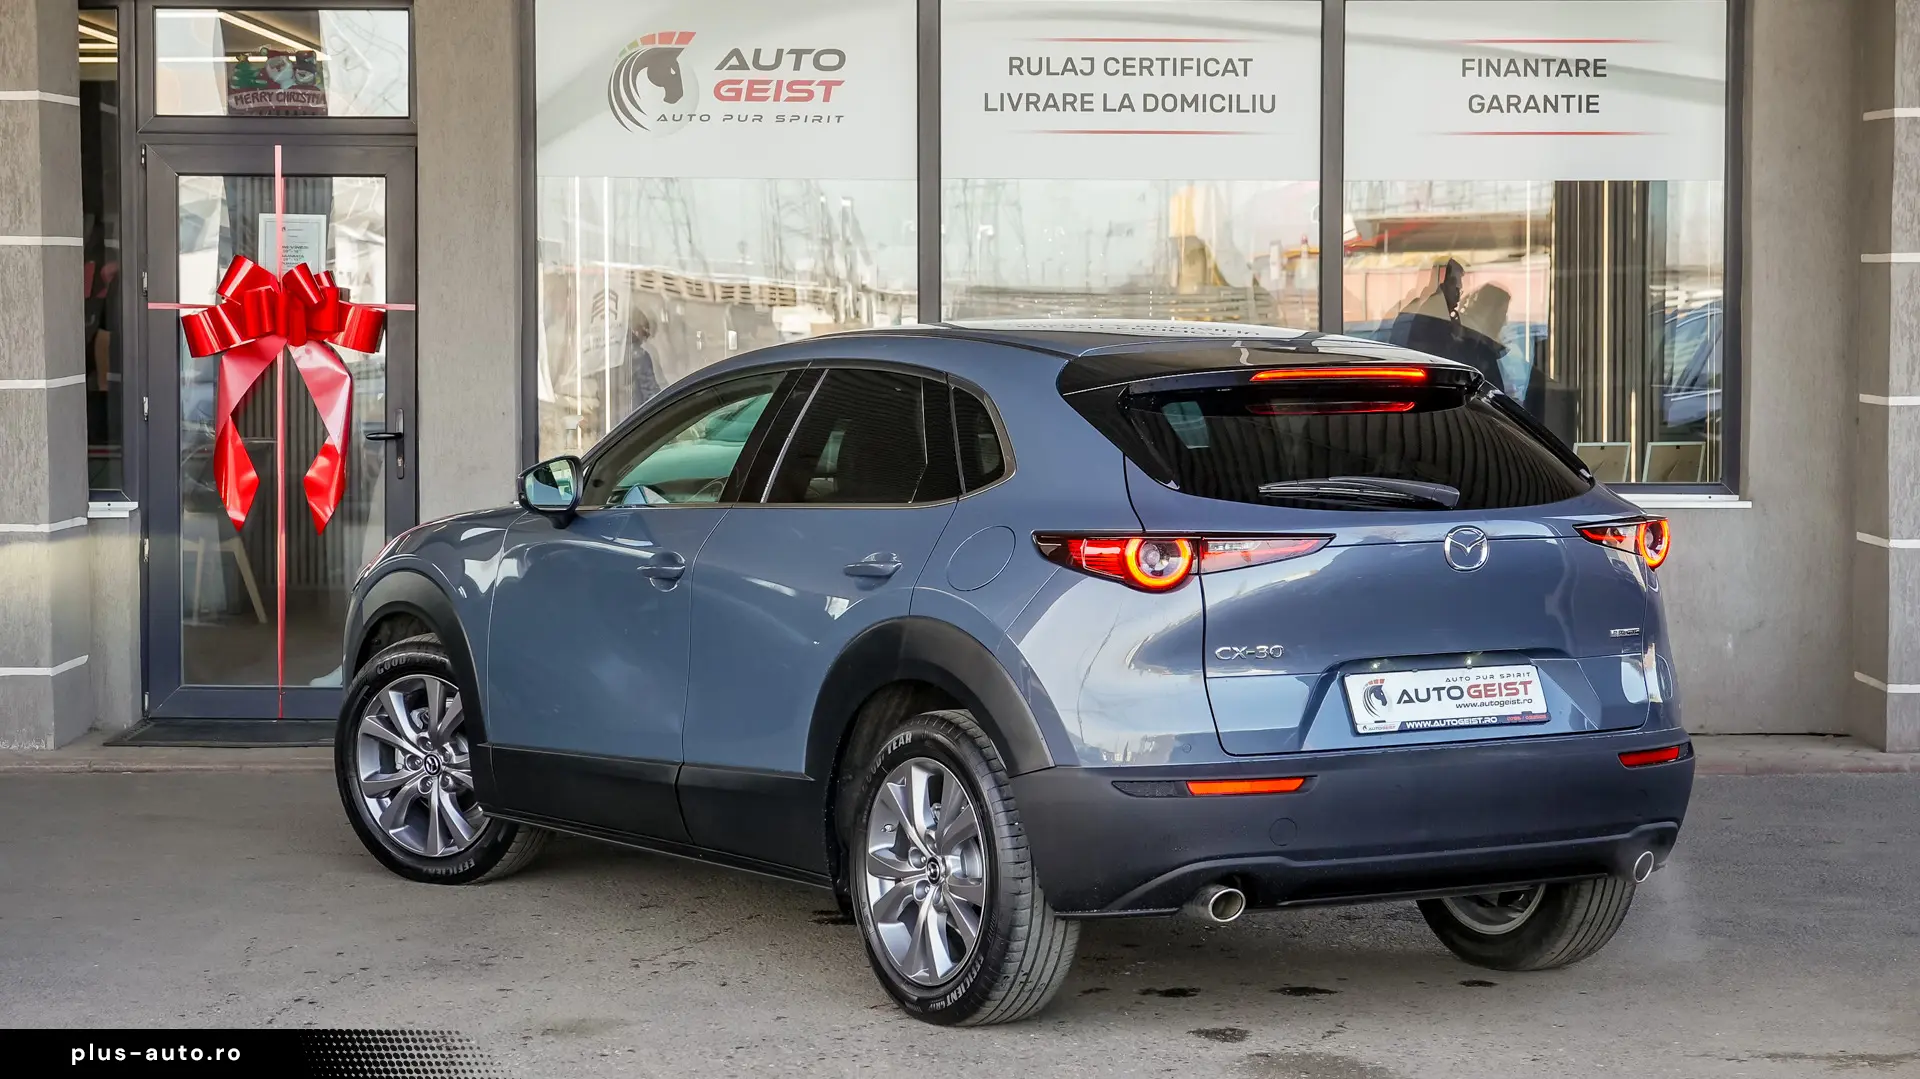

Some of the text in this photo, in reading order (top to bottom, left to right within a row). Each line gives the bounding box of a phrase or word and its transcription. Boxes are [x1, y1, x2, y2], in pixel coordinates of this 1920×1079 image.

[714, 48, 847, 72] AUTO
[1008, 56, 1254, 78] RULAJ CERTIFICAT
[1461, 58, 1608, 78] FINANTARE
[234, 91, 274, 106] MERRY
[713, 79, 846, 103] GEIST
[983, 92, 1277, 114] LIVRARE LA DOMICILIU
[1468, 94, 1600, 114] GARANTIE
[656, 113, 846, 124] AUTO PUR SPIRIT
[1215, 645, 1284, 660] CX-30
[1499, 671, 1532, 679] SPIRIT
[1456, 697, 1533, 709] www.autogeist.ro
[1406, 716, 1498, 730] WWW.AUTOGEIST.RO
